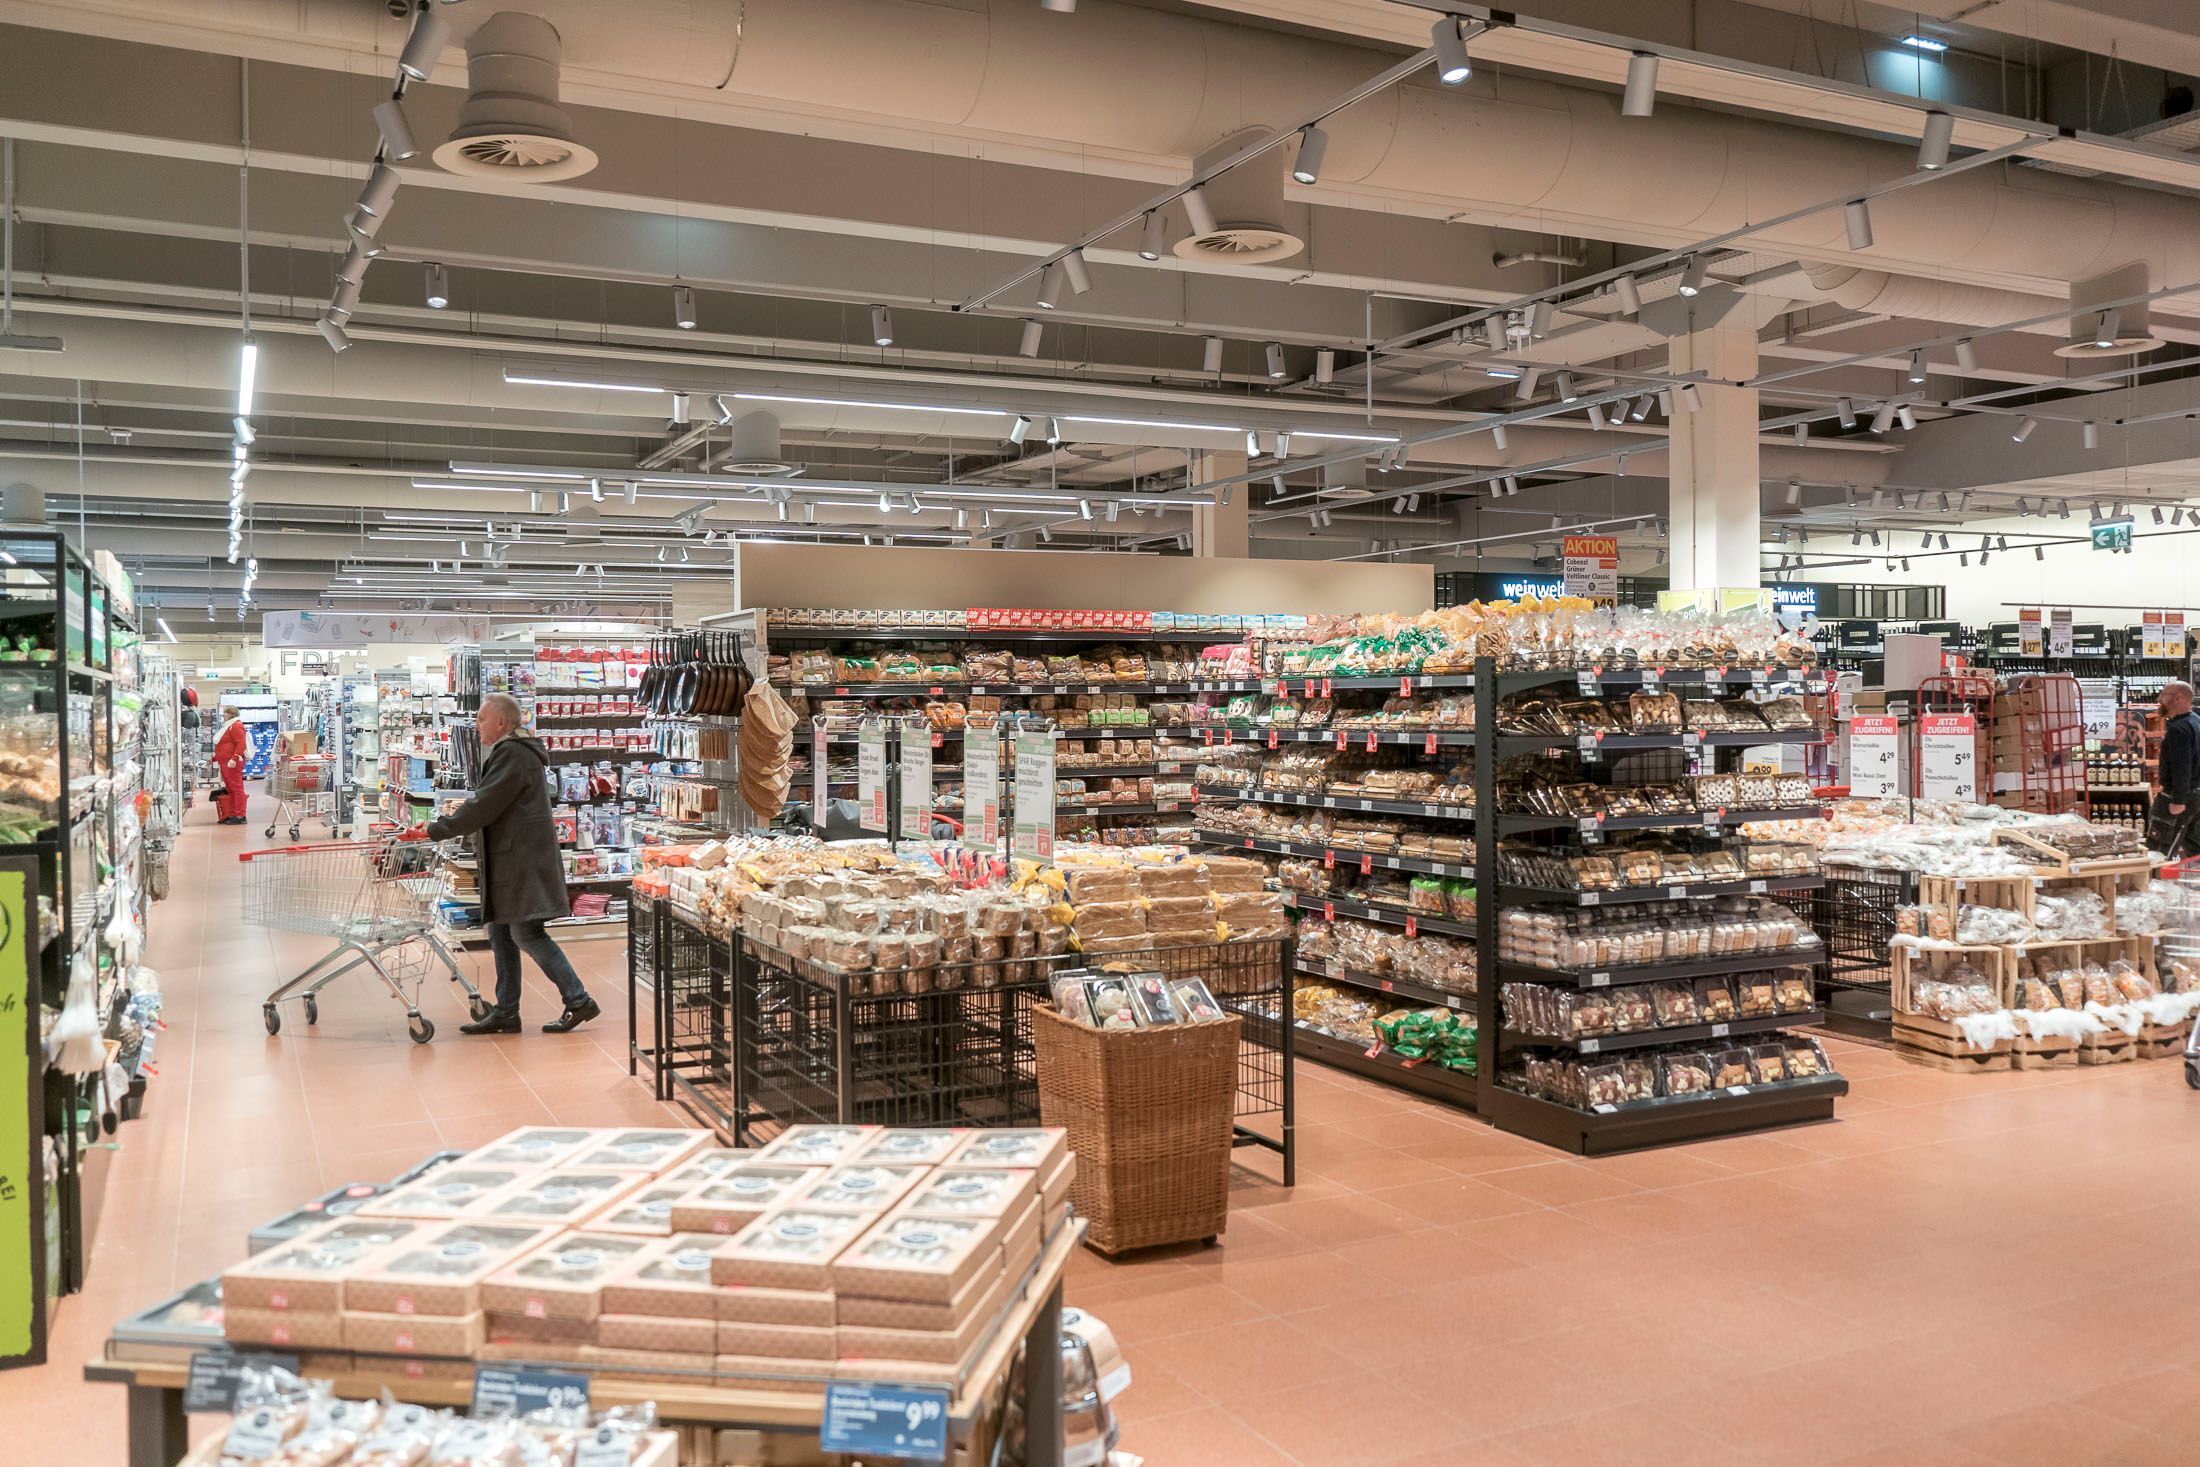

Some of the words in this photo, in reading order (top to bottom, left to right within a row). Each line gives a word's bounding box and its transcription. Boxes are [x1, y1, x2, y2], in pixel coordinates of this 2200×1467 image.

[1565, 539, 1615, 554] AKTION
[1566, 558, 1588, 566] Cobenzl
[1566, 572, 1590, 580] Veltliner
[1592, 572, 1610, 580] Classic
[1770, 586, 1816, 604] einwelt
[1863, 718, 1884, 726] JETZT
[1937, 718, 1959, 726] JETZT
[1854, 726, 1894, 734] ZUGREIFEN!
[1926, 726, 1969, 734] ZUGREIFEN!
